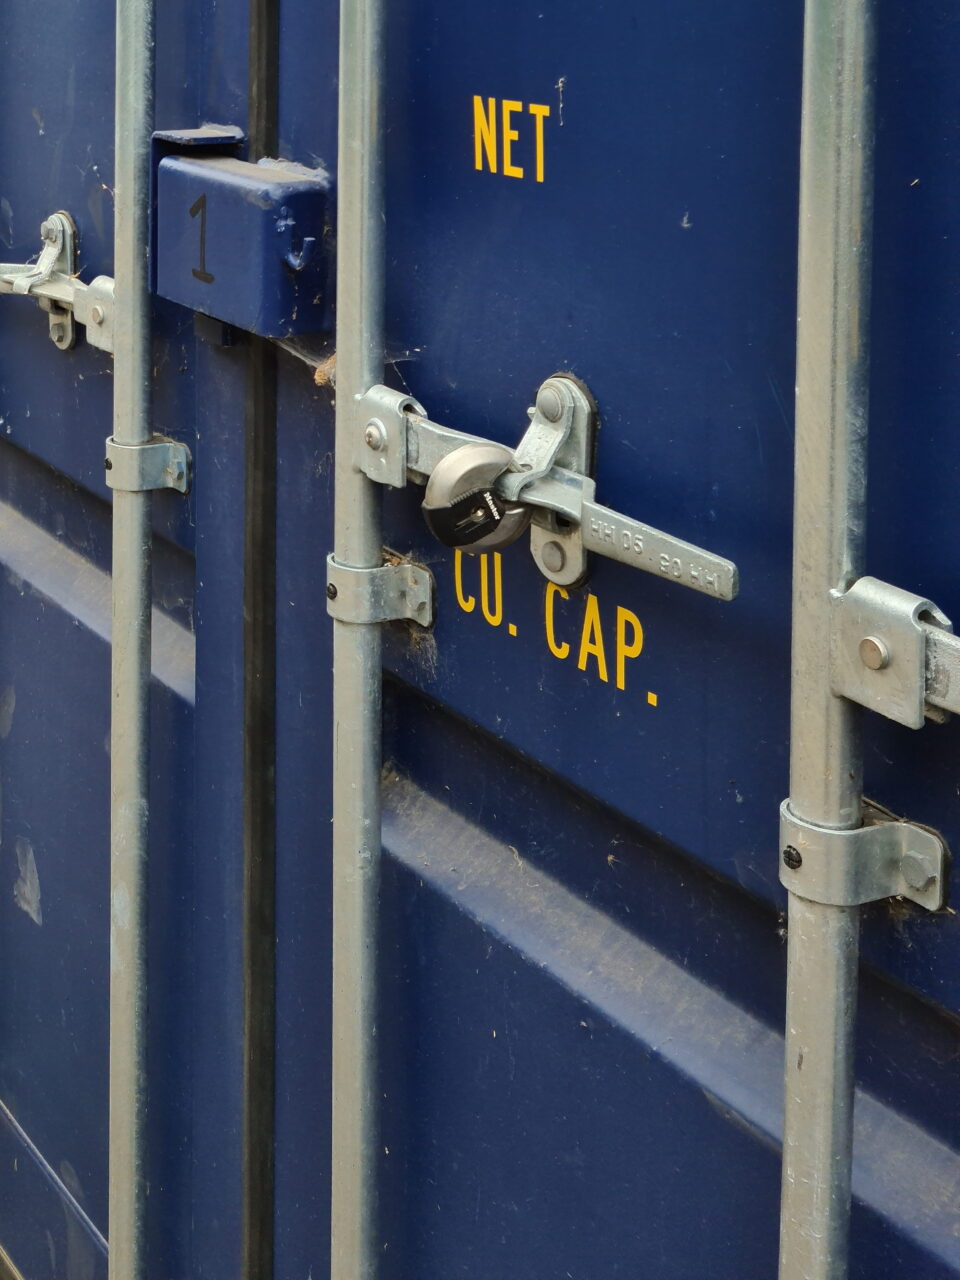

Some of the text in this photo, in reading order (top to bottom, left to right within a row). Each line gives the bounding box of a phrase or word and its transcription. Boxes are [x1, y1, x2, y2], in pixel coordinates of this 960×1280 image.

[473, 95, 551, 183] NET
[189, 192, 216, 285] 1
[453, 549, 658, 708] CU. CAP.
